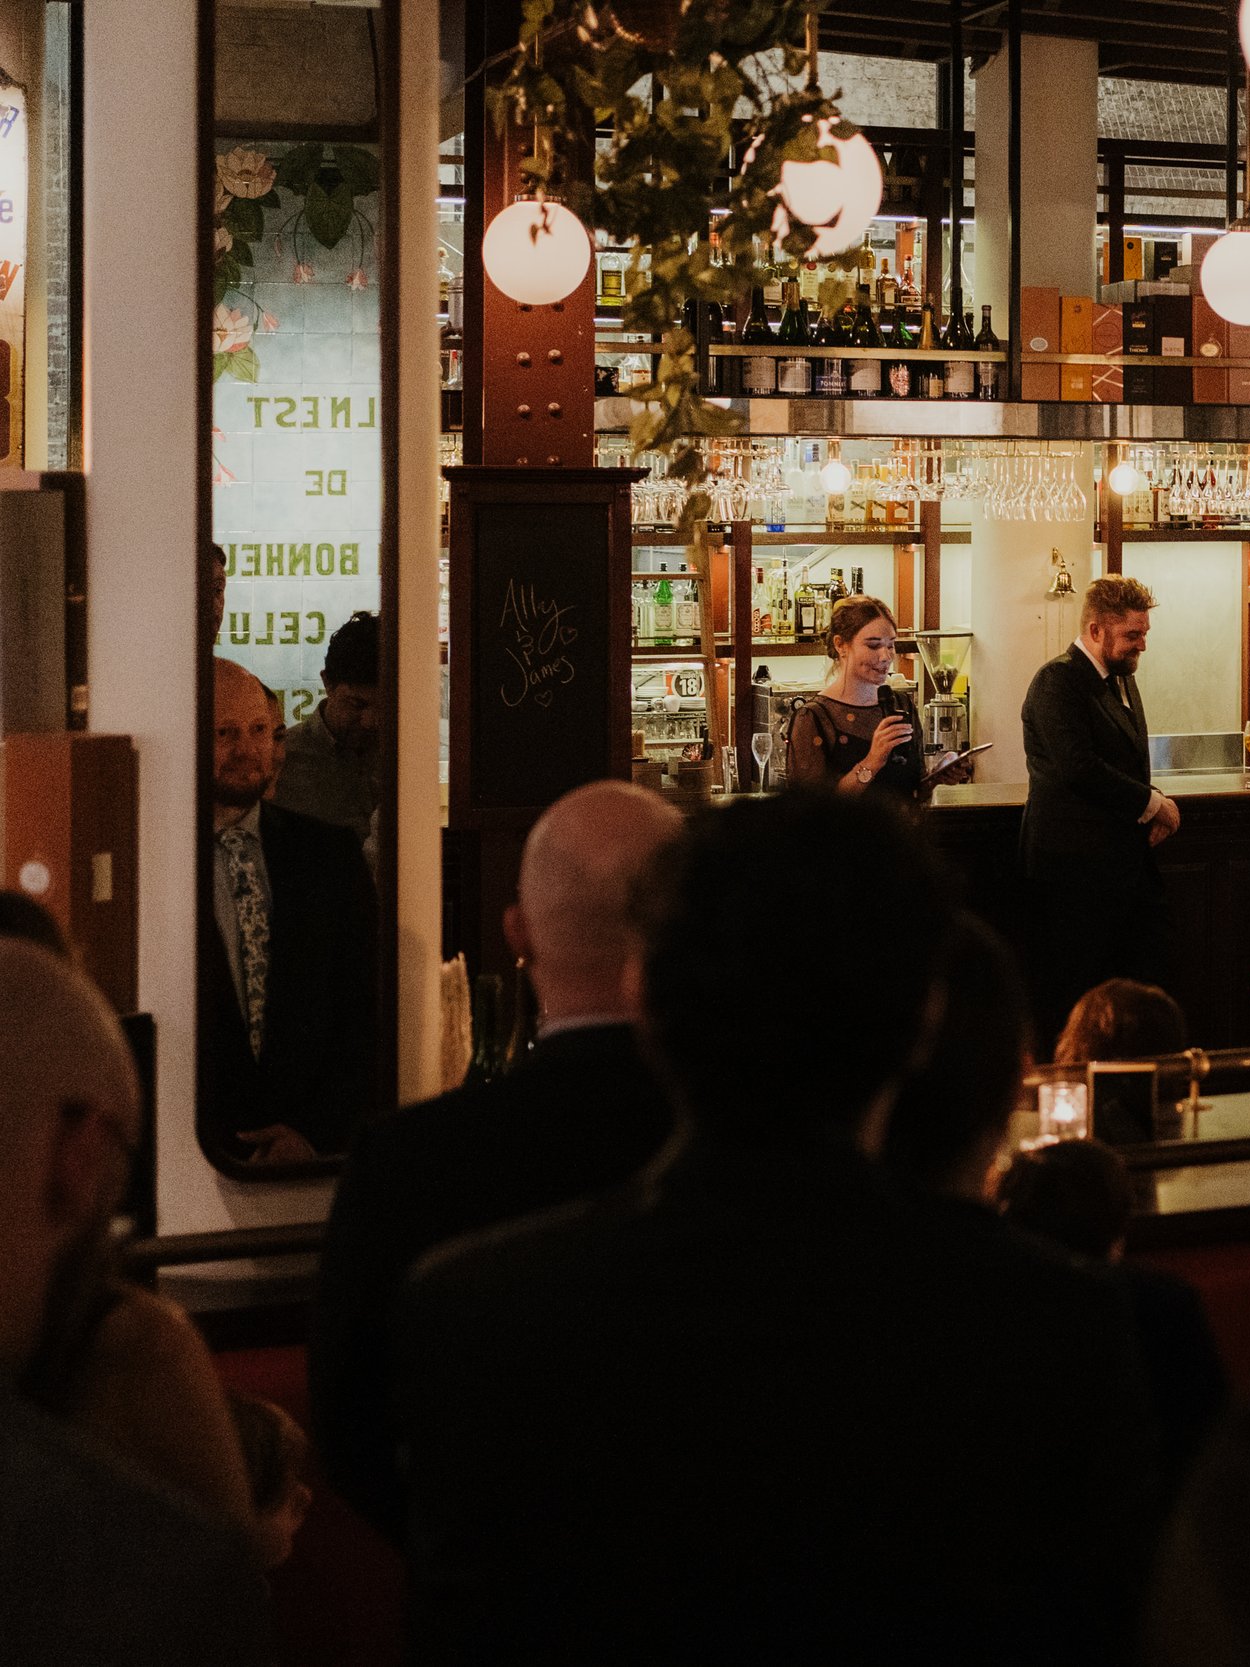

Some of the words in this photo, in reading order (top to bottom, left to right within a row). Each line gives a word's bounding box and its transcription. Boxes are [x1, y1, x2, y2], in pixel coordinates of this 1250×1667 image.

[497, 577, 576, 656] Ally
[498, 646, 575, 707] James
[679, 678, 697, 696] 18
